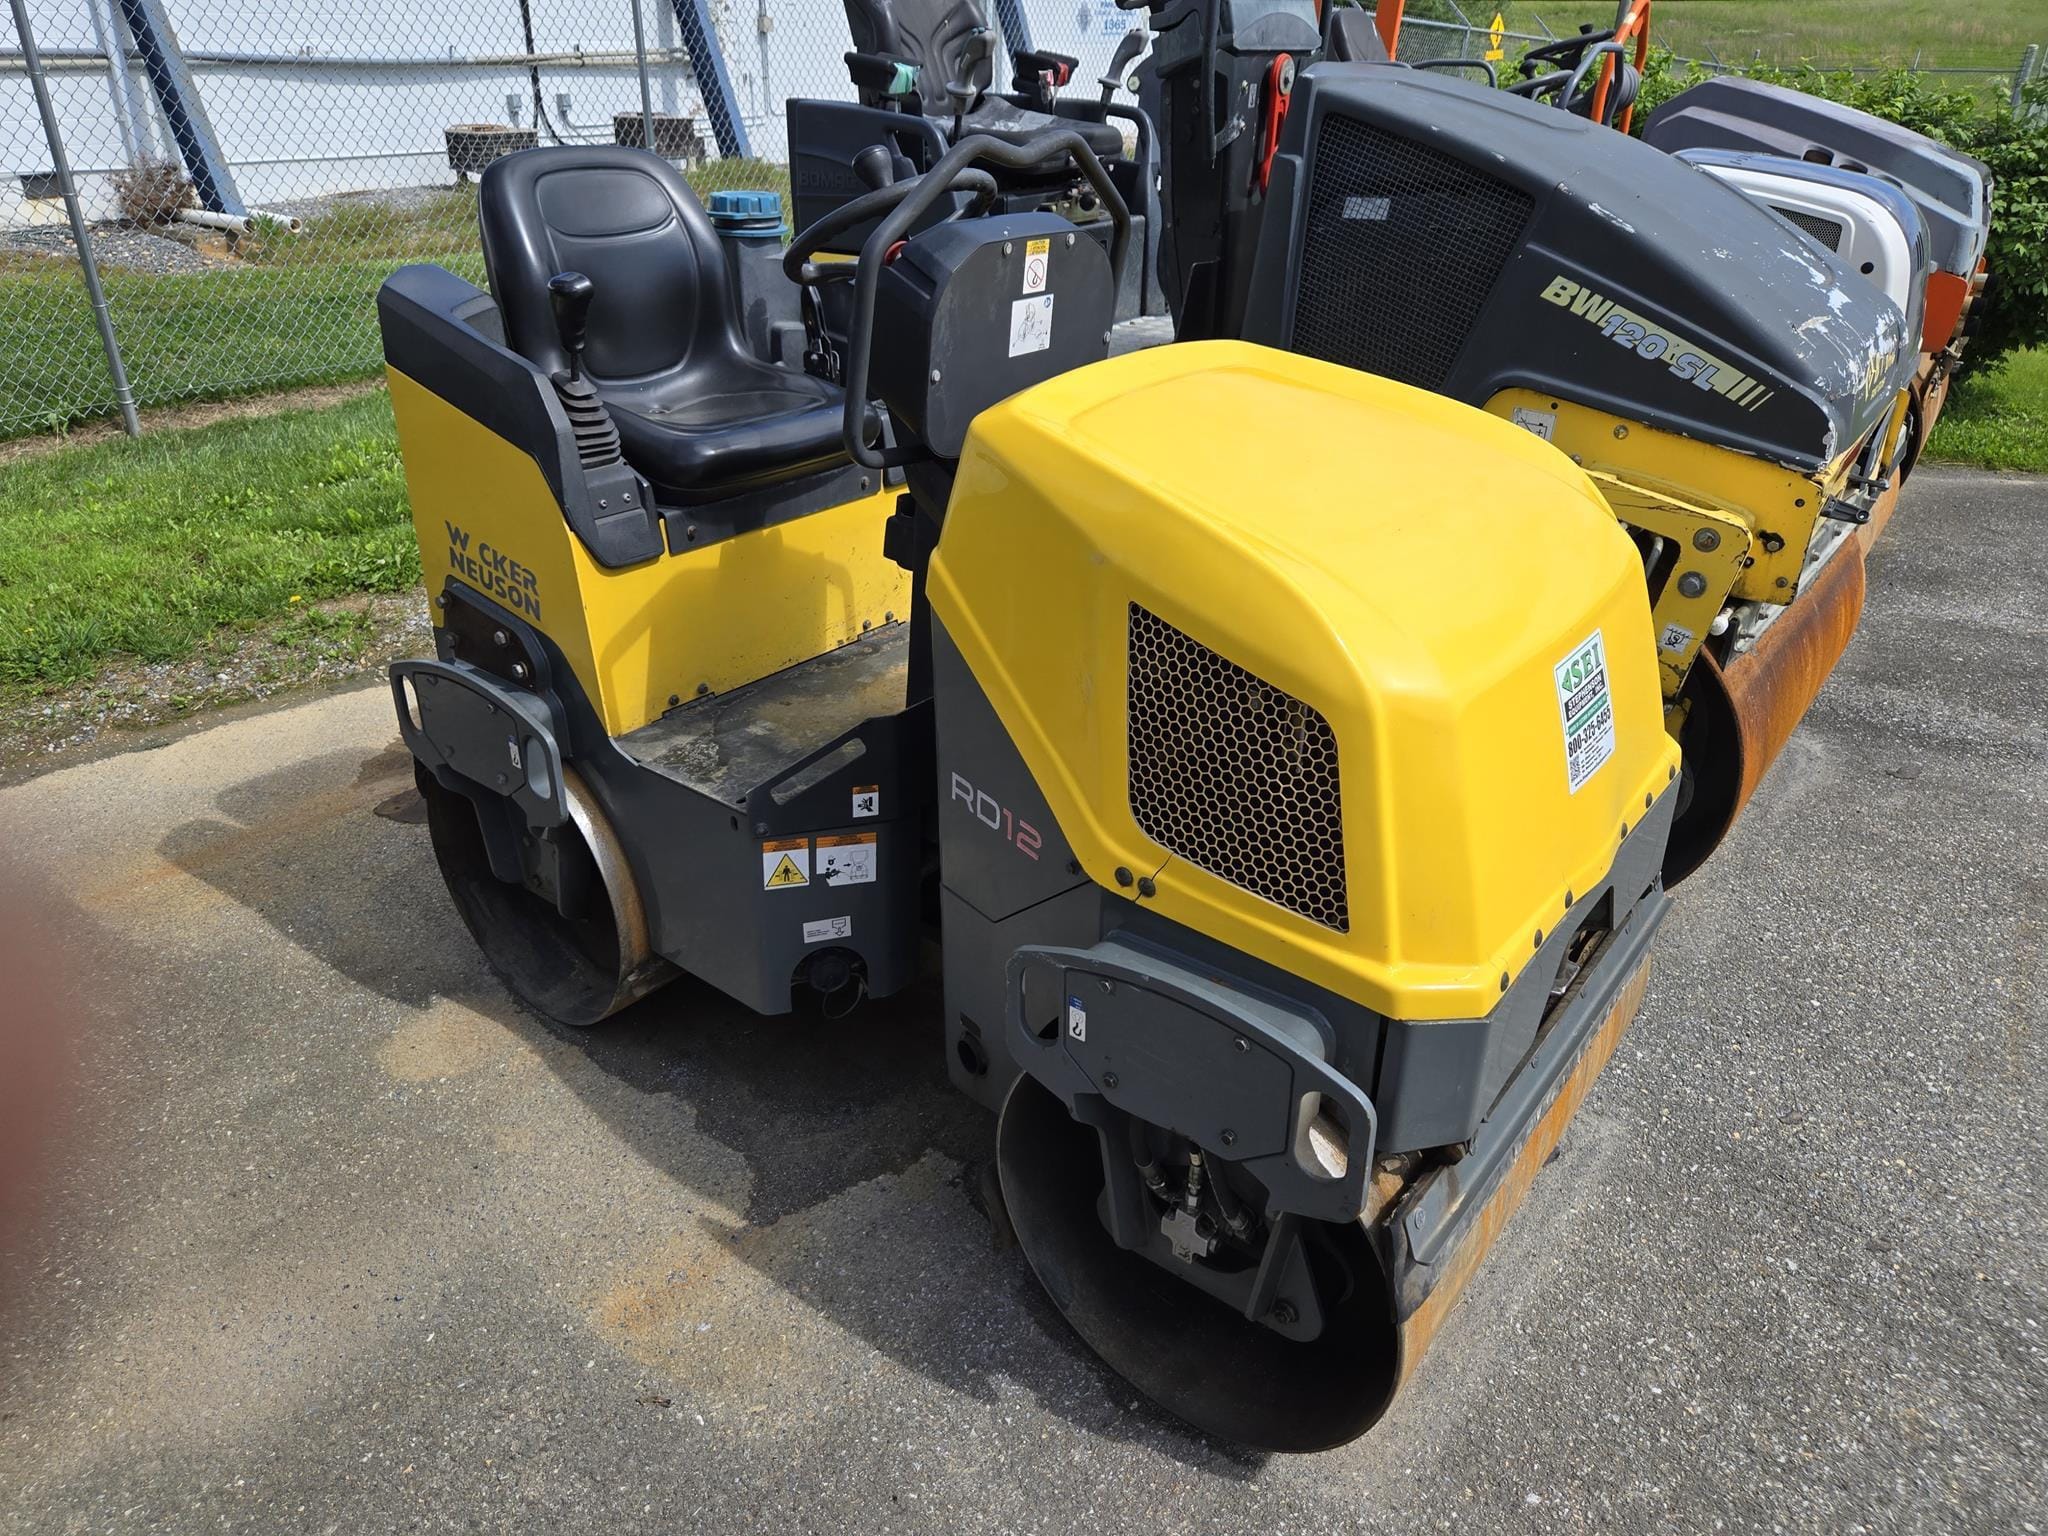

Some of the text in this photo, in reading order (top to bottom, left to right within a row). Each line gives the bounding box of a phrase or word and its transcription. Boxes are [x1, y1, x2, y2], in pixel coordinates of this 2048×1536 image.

[449, 546, 541, 621] NEUSON
[1568, 672, 1602, 710] STEPHENSON
[1570, 643, 1601, 690] SEI
[1567, 704, 1611, 758] 800-325-6455
[952, 771, 1042, 860] RD12
